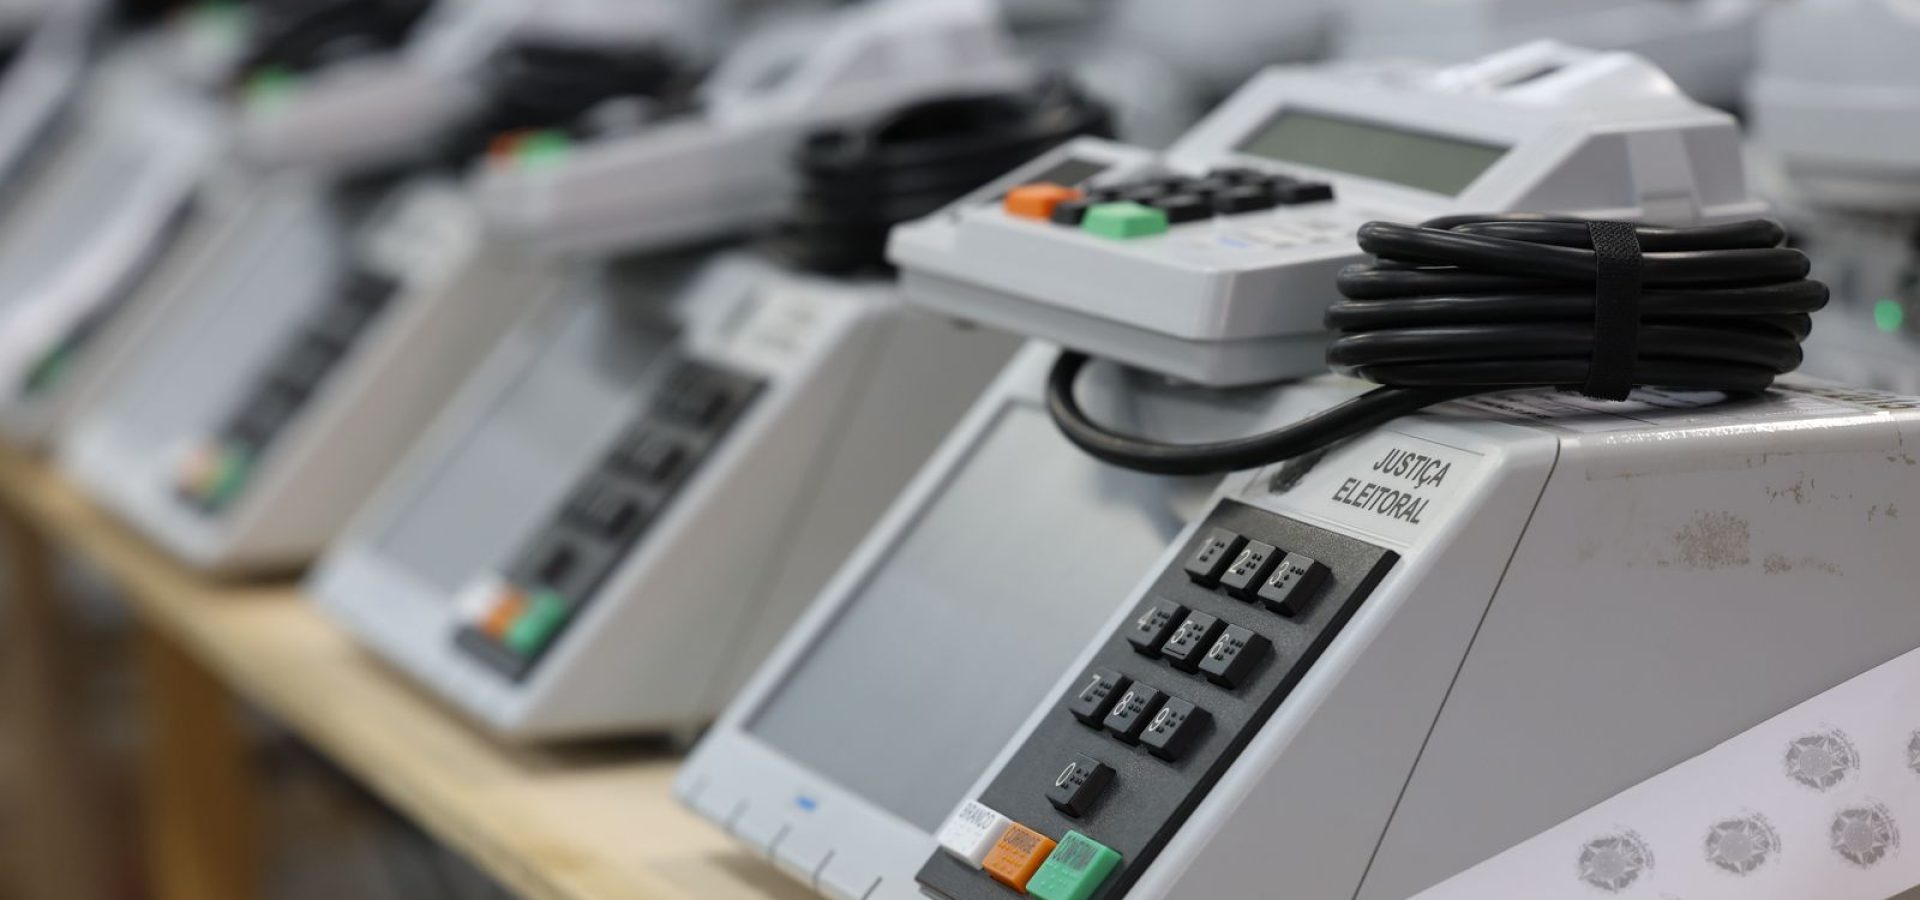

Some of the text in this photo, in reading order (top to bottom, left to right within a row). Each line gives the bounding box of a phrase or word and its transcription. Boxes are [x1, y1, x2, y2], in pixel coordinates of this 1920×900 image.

[1372, 448, 1452, 489] JUSTIÇA
[1331, 477, 1430, 524] ELEITORAL
[1196, 535, 1290, 585] 1 2 3
[1136, 606, 1230, 658] 4 5 6
[1078, 674, 1170, 731] 7 8 9
[1055, 762, 1076, 787] 0
